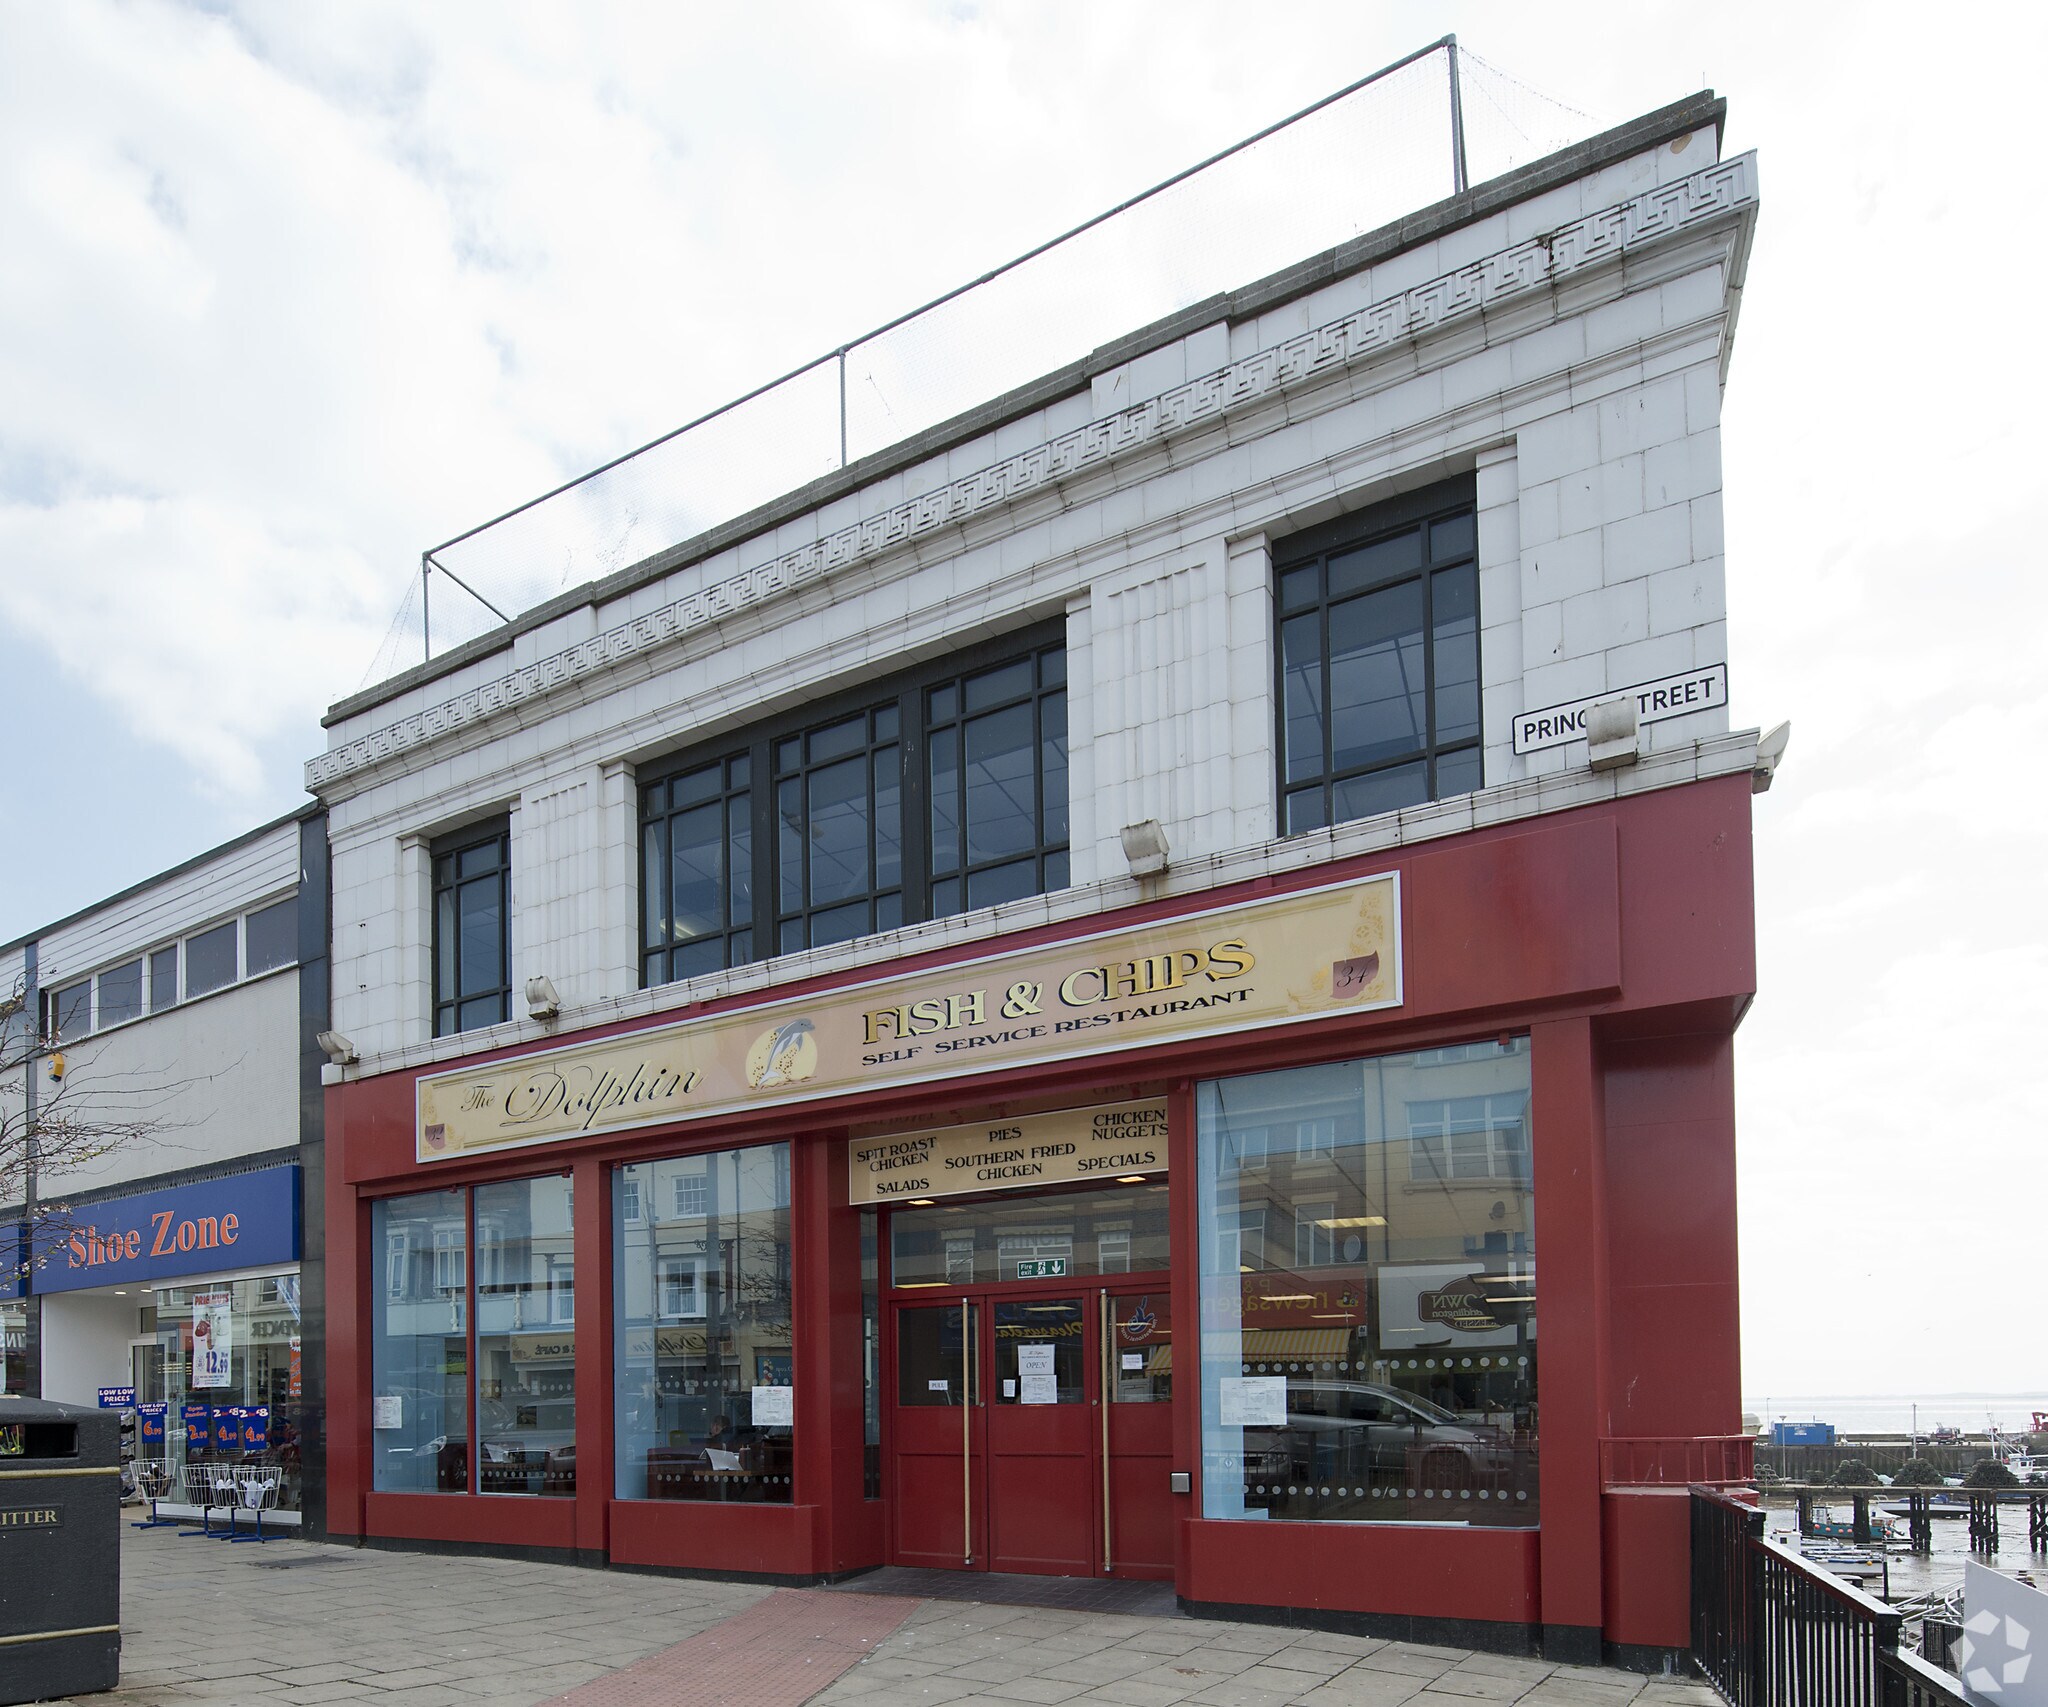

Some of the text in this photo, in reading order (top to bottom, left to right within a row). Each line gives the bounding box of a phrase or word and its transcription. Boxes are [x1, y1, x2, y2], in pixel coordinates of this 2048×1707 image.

[1637, 676, 1715, 714] TREET
[1336, 963, 1371, 987] 34
[863, 938, 1256, 1045] FISH & CHIPS
[862, 988, 1255, 1066] SELF SERVICE RESTAURANT
[461, 1060, 704, 1131] The Dolphin
[1093, 1109, 1166, 1127] CHICKEN
[988, 1127, 1022, 1142] PIES
[1091, 1123, 1169, 1141] NUGGETS
[856, 1137, 937, 1163] SPIT ROAST
[944, 1143, 1076, 1171] SOUTHERN FRIED
[869, 1151, 929, 1173] CHICKEN
[1077, 1151, 1156, 1172] SPECIALS
[977, 1163, 1043, 1181] CHICKEN
[876, 1178, 930, 1195] SALADS
[69, 1211, 239, 1269] Shoe Zone
[1020, 1263, 1033, 1271] Fire
[206, 1351, 229, 1374] 12.99
[1026, 1361, 1048, 1369] OPEN
[213, 1409, 222, 1418] 2
[239, 1409, 248, 1418] 2
[143, 1421, 162, 1436] 6.99
[0, 1510, 57, 1526] ITTER
